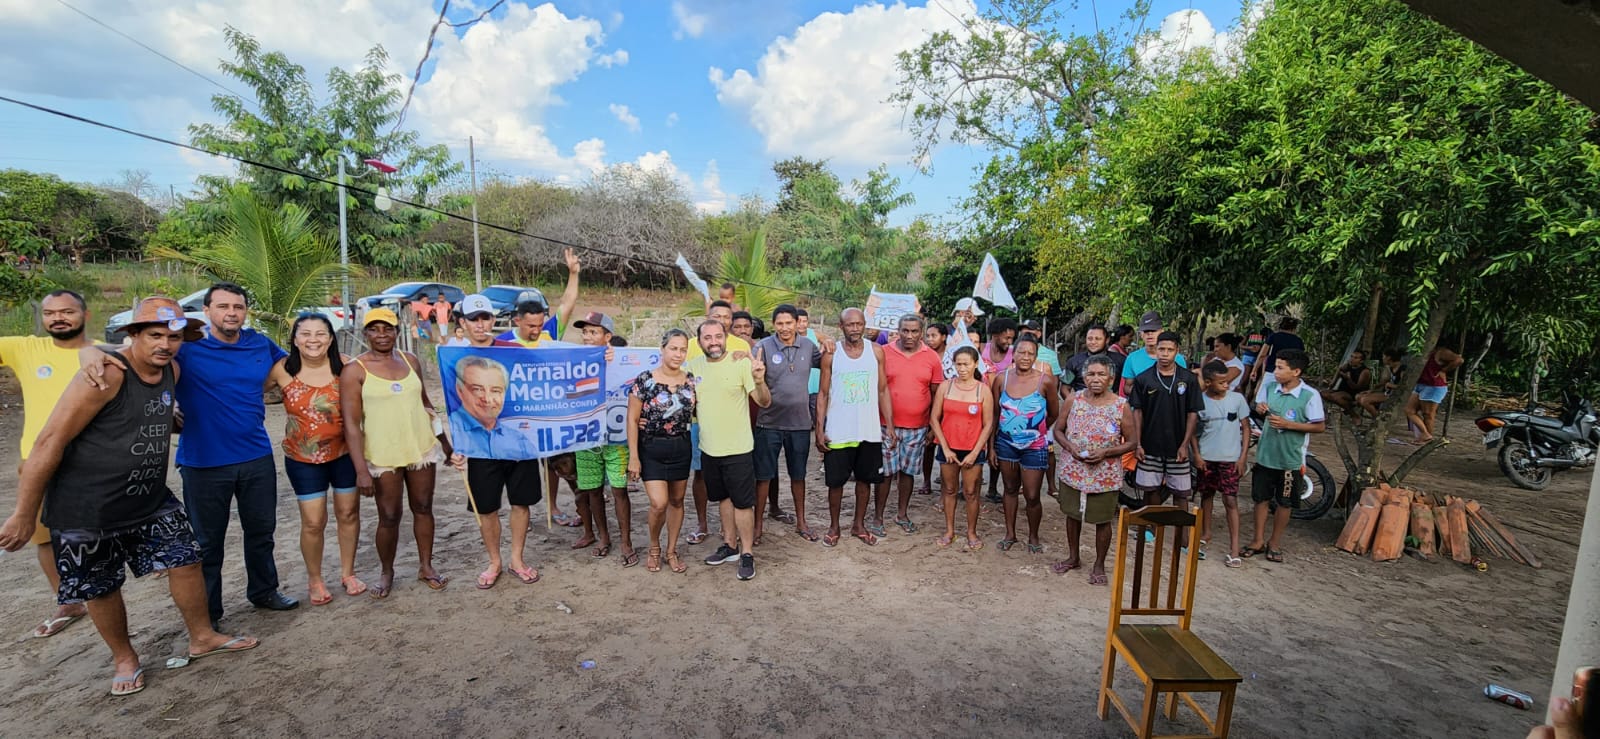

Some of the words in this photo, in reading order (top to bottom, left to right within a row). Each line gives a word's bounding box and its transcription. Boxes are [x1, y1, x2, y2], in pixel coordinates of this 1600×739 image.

[510, 360, 600, 382] Arnaldo
[510, 382, 565, 401] Melo
[522, 401, 569, 412] MARANHÃO
[570, 399, 598, 408] CONFIA
[138, 423, 168, 438] KEEP
[537, 419, 600, 452] 11.222
[141, 457, 162, 466] AND
[128, 466, 162, 482] RIDE
[126, 483, 153, 496] ON
